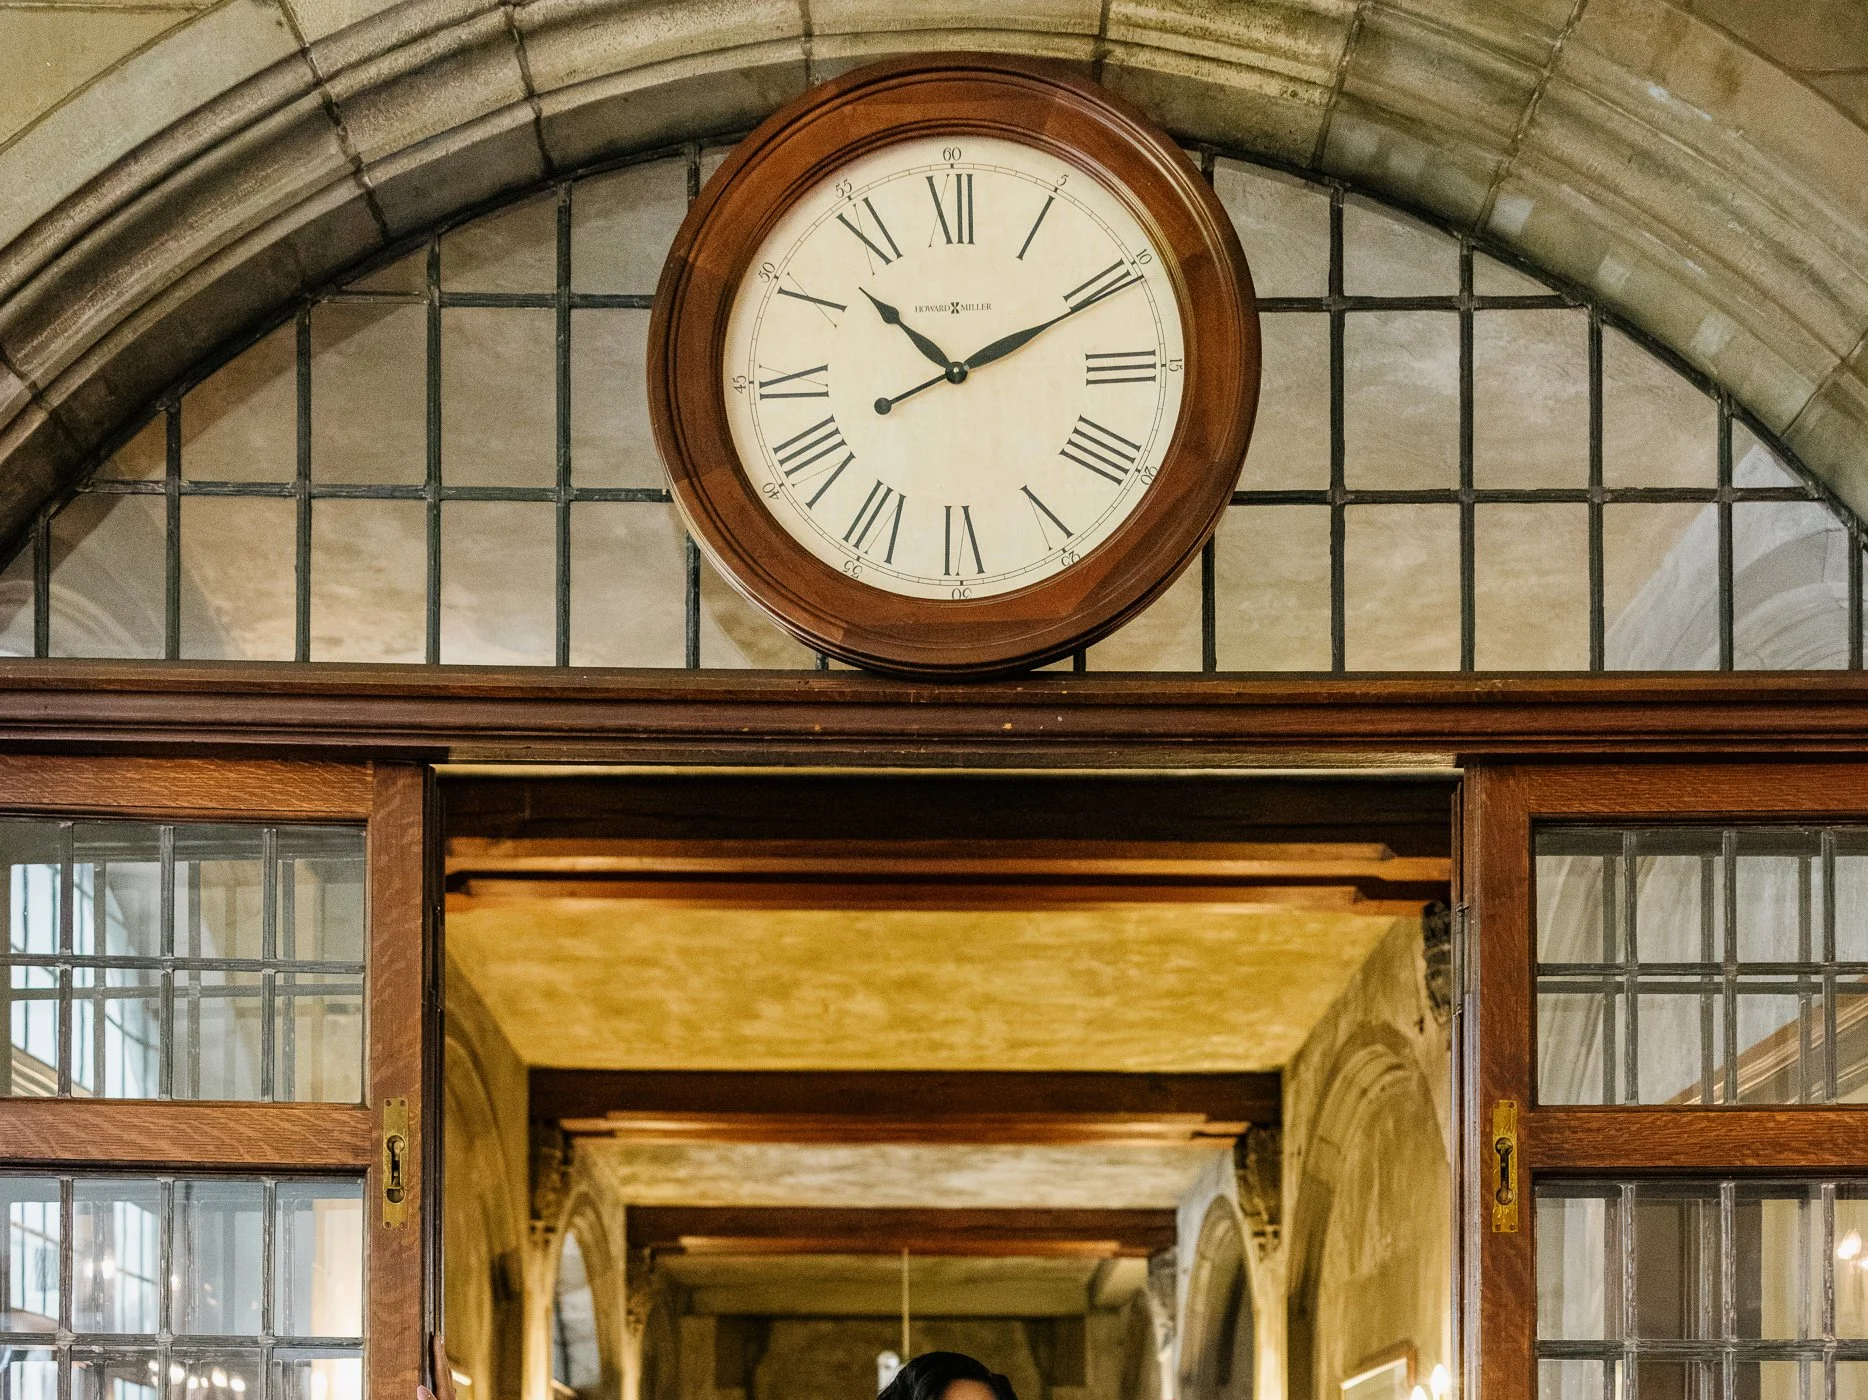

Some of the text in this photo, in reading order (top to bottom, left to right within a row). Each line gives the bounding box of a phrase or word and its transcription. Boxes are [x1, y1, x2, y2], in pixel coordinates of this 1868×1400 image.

[942, 146, 961, 163] 60
[833, 178, 853, 198] 55
[1056, 173, 1070, 186] 5
[926, 173, 974, 248] XII
[836, 197, 903, 275] XI
[1016, 195, 1055, 260] I
[1135, 248, 1152, 265] 10
[759, 262, 775, 283] 50
[1063, 259, 1132, 312] II
[777, 272, 848, 328] X
[914, 302, 992, 313] HOWARD MILLER
[1085, 349, 1157, 386] III
[1169, 357, 1182, 373] 15
[733, 374, 746, 394] 45
[758, 364, 830, 400] IX
[1058, 415, 1142, 486] IIII
[772, 414, 856, 510] VIII
[1140, 464, 1158, 486] 20
[762, 482, 780, 500] 40
[843, 479, 907, 565] VII
[1020, 485, 1074, 551] V
[943, 505, 985, 575] VI
[842, 558, 863, 578] 35
[1061, 551, 1080, 567] 25
[952, 587, 971, 600] 30
